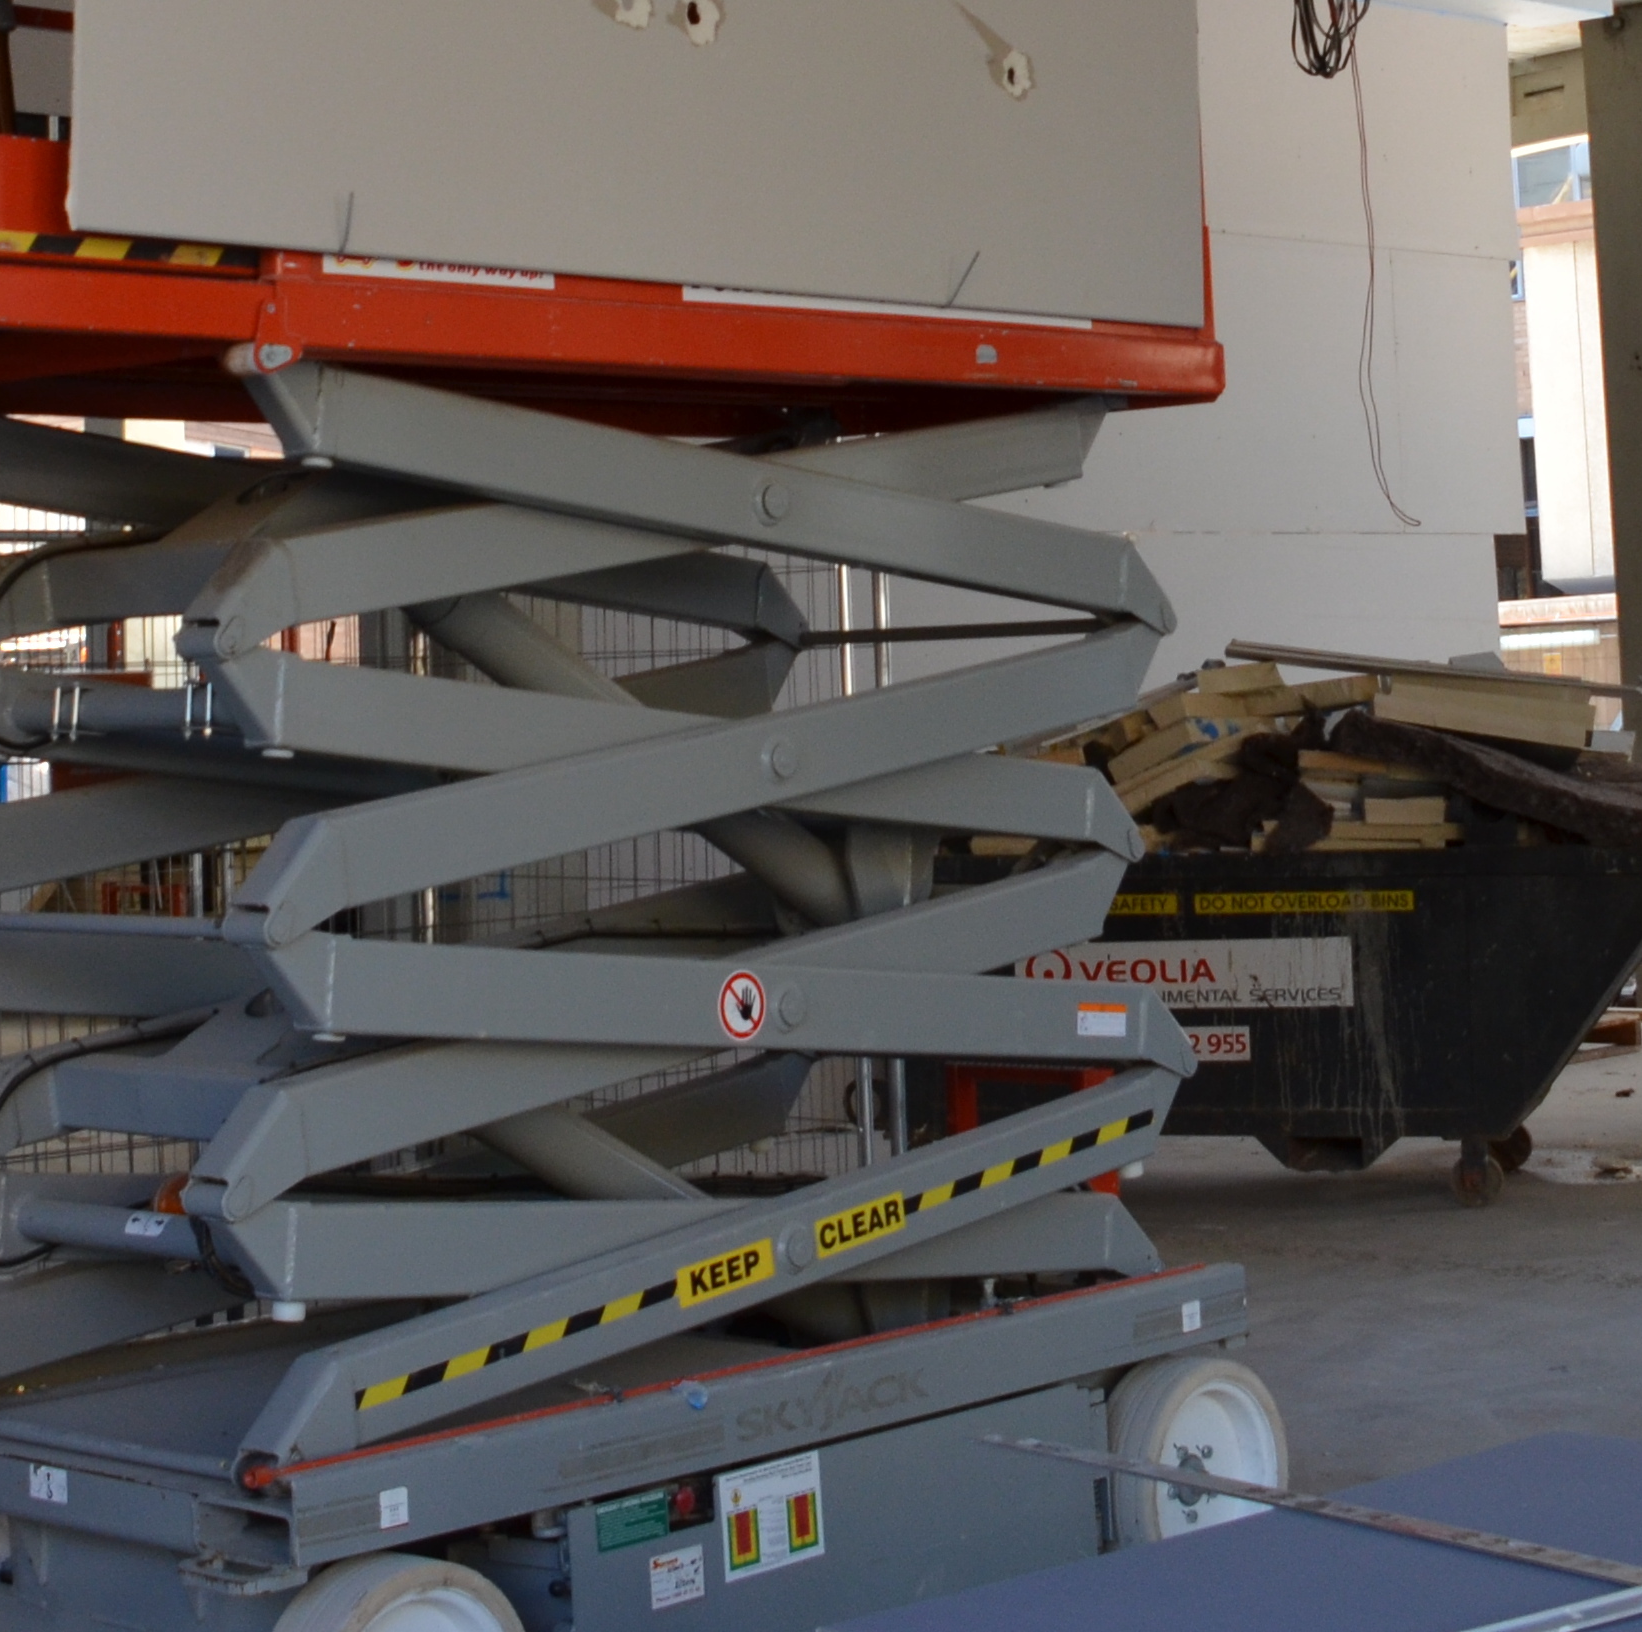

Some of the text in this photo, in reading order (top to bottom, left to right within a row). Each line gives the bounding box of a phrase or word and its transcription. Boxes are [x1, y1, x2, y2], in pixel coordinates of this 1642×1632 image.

[1199, 893, 1408, 911] DO NOT OVERLOAD BINS
[1079, 958, 1216, 983] VEOLIA
[1249, 987, 1342, 1003] SERVICES
[1206, 1033, 1247, 1054] 955
[689, 1199, 901, 1297] KEEP CLEAR
